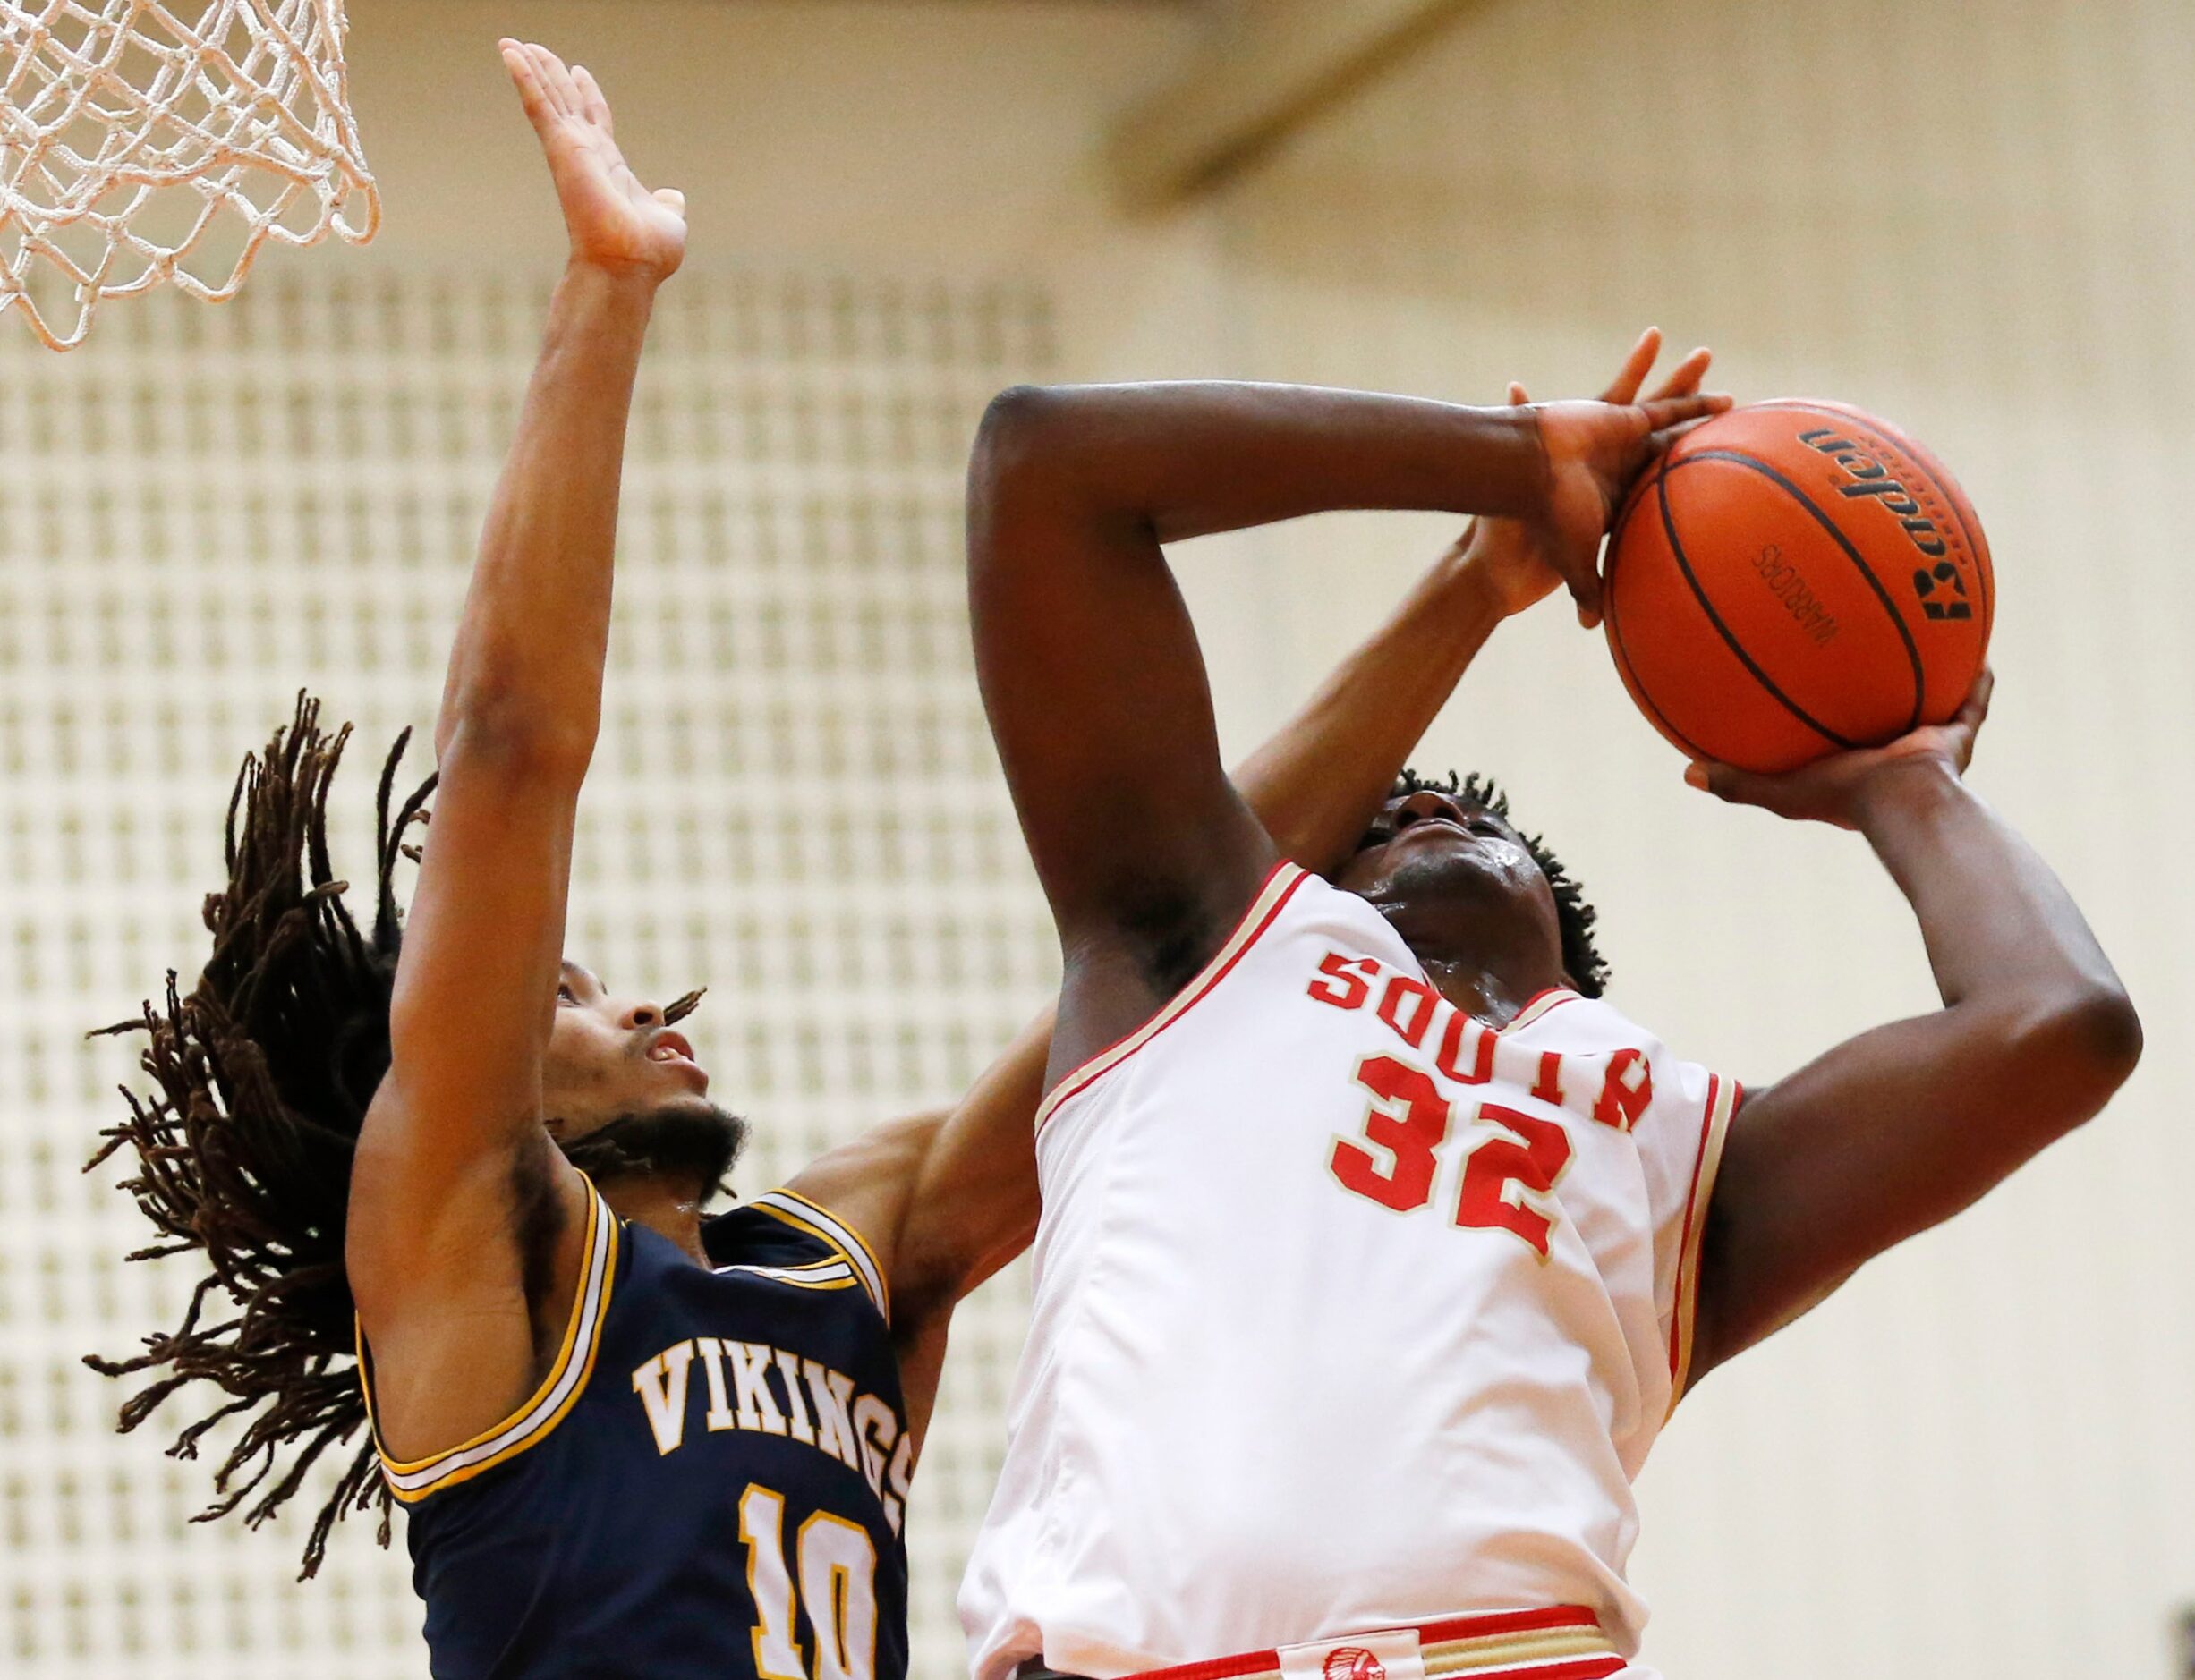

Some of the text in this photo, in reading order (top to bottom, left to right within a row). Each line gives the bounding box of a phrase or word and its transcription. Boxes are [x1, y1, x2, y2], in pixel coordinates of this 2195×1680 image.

[1798, 428, 1973, 621] Baden
[1326, 1049, 1577, 1267] 32
[737, 1481, 879, 1680] 10
